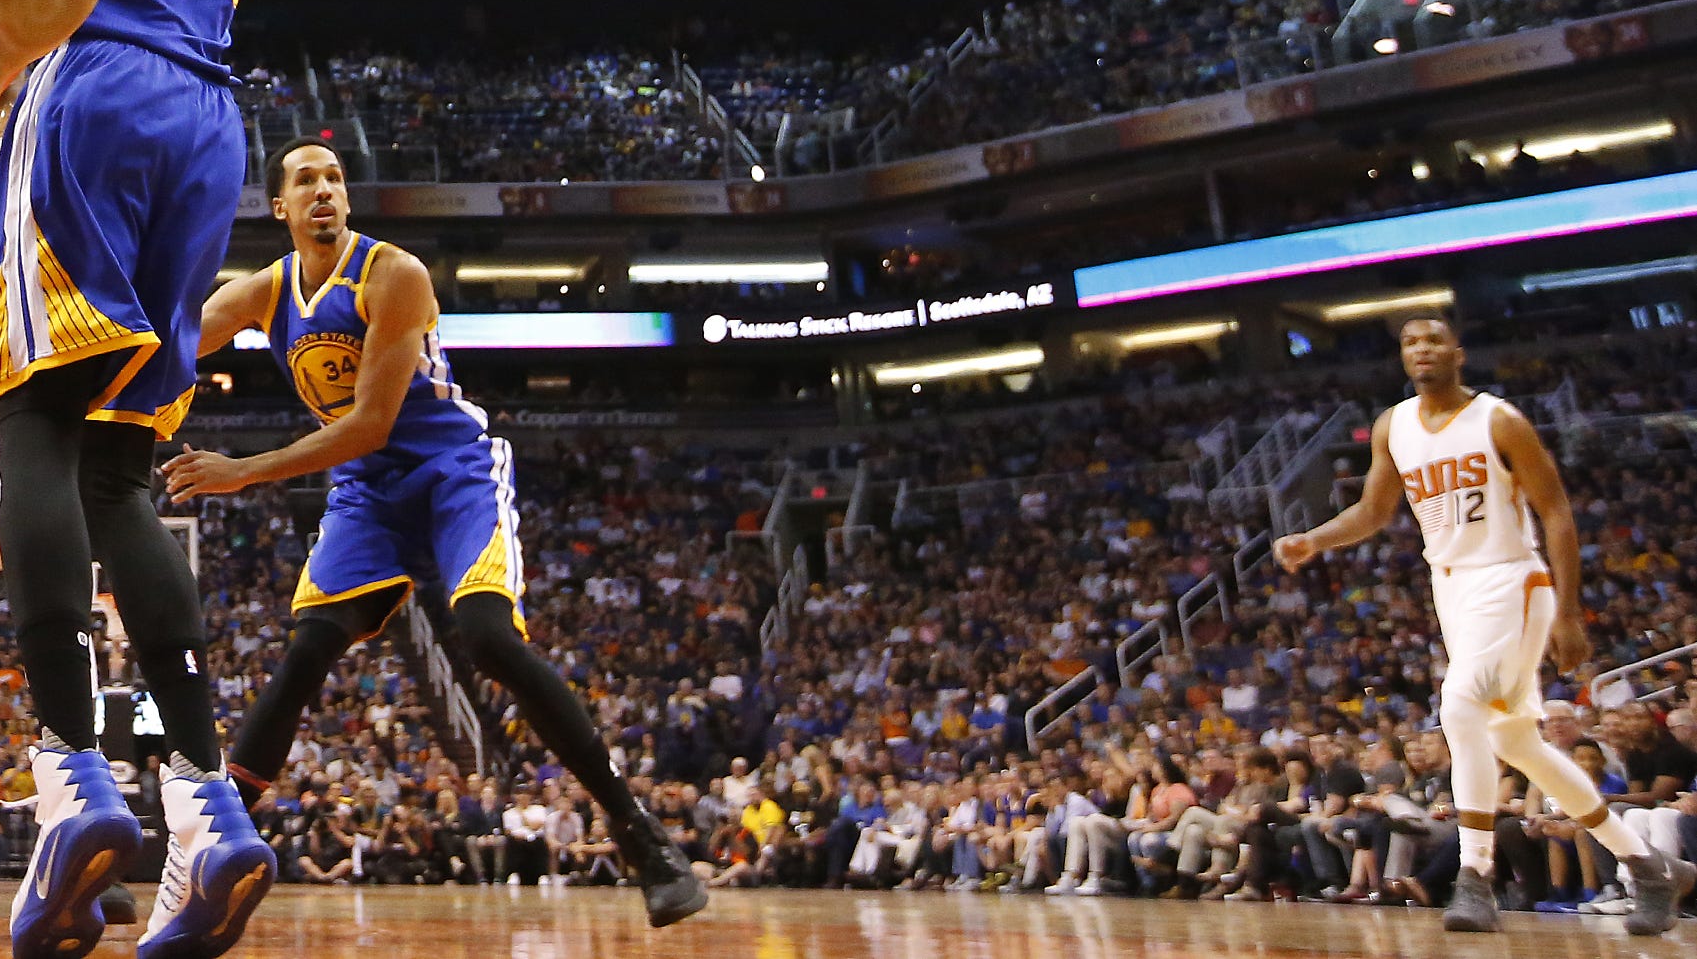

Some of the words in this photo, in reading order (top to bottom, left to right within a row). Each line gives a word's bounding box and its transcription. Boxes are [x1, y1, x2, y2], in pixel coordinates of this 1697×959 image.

[727, 319, 799, 339] TALKING
[799, 316, 849, 336] STICK
[848, 309, 917, 332] RESORT
[929, 291, 1026, 322] Scottsdale,
[1027, 283, 1054, 307] AZ
[322, 355, 359, 382] 34
[1400, 453, 1488, 505] SUNS
[1454, 489, 1485, 524] 12
